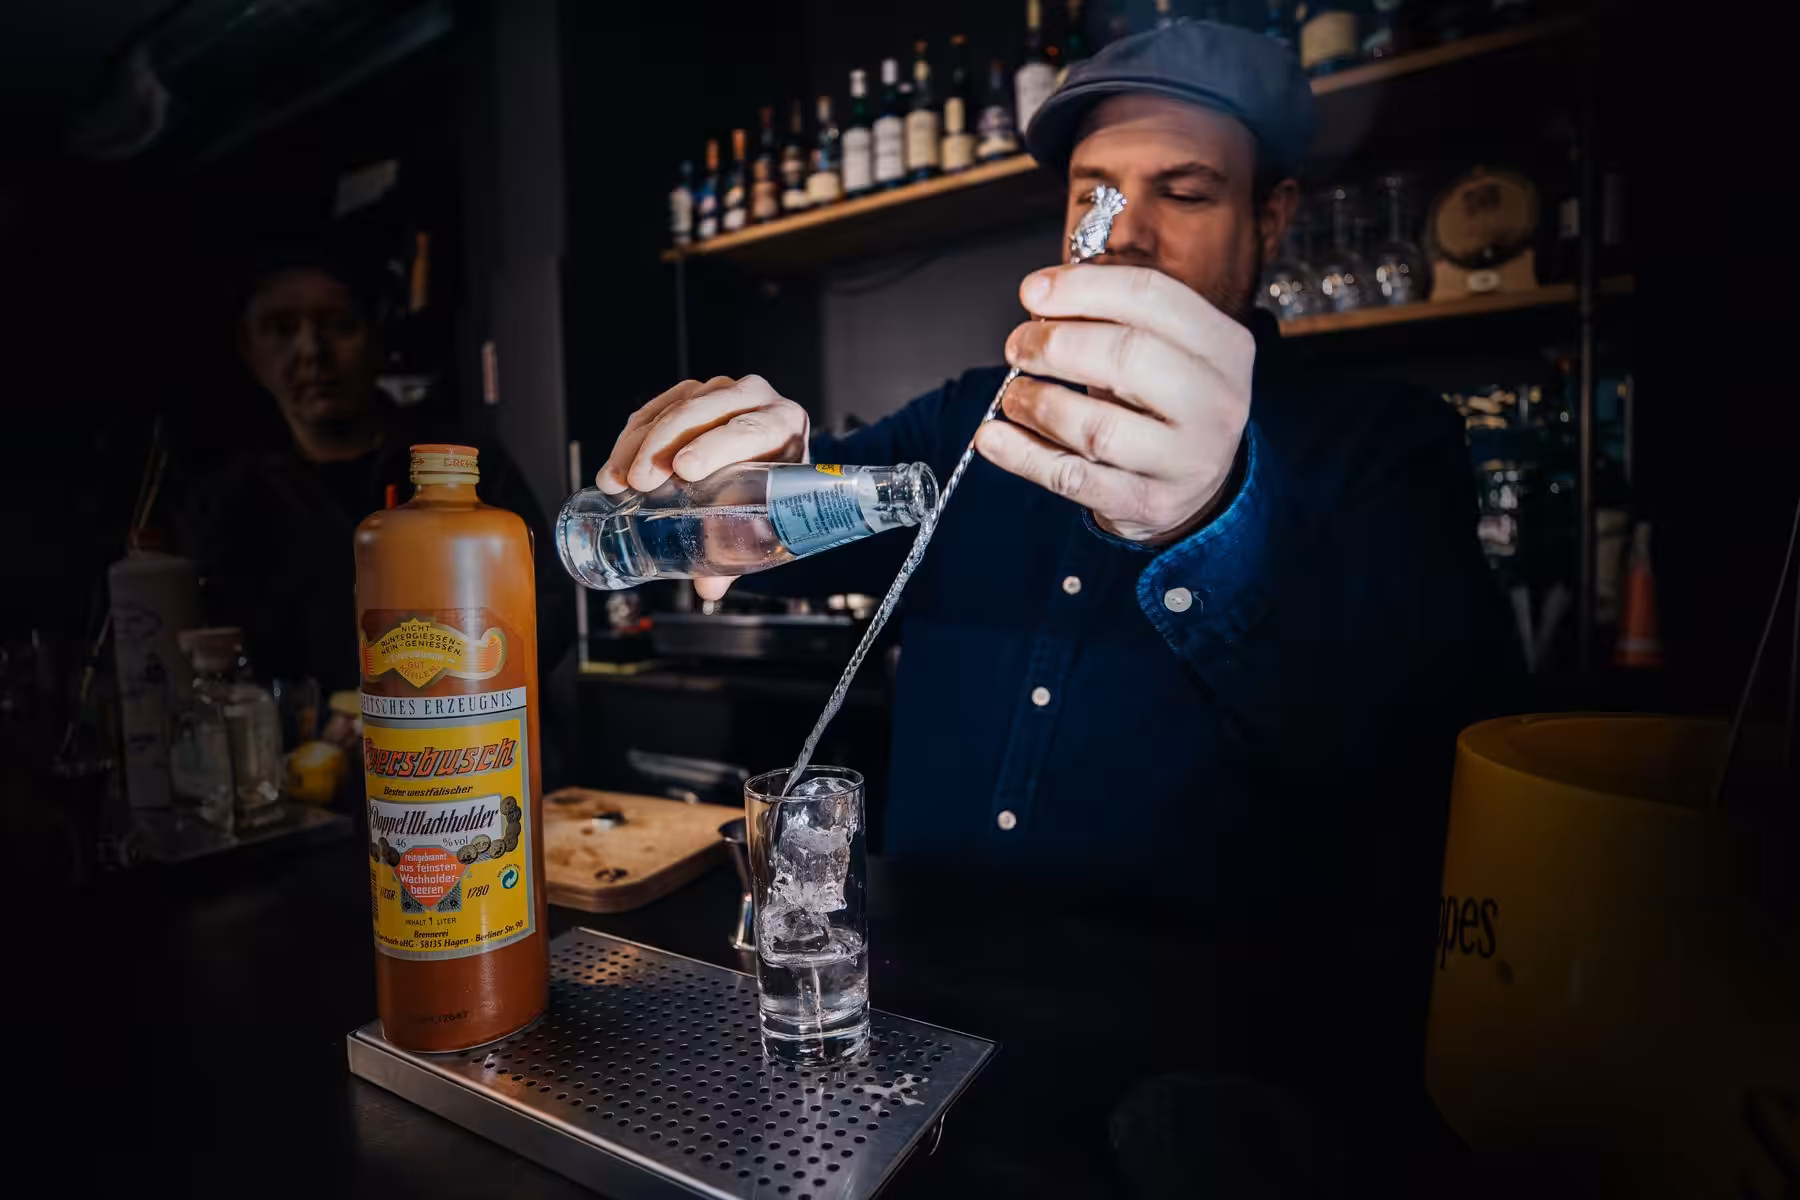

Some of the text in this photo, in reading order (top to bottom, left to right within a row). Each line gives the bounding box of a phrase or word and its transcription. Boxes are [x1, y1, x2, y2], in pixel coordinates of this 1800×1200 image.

[401, 624, 430, 632] NICHT
[425, 691, 512, 714] ERZEUGNIS
[383, 785, 473, 797] Bester westfälischer
[395, 838, 407, 848] 46
[399, 862, 457, 873] aus feinsten
[400, 873, 460, 885] Wachholder-
[410, 884, 443, 895] beeren
[466, 884, 489, 899] 1780
[428, 916, 433, 926] 1
[436, 917, 457, 926] LITER
[400, 939, 414, 948] oHG
[420, 940, 442, 949] 58135
[444, 938, 469, 949] Hagen
[475, 929, 504, 943] Berliner
[414, 930, 449, 939] Brennerei
